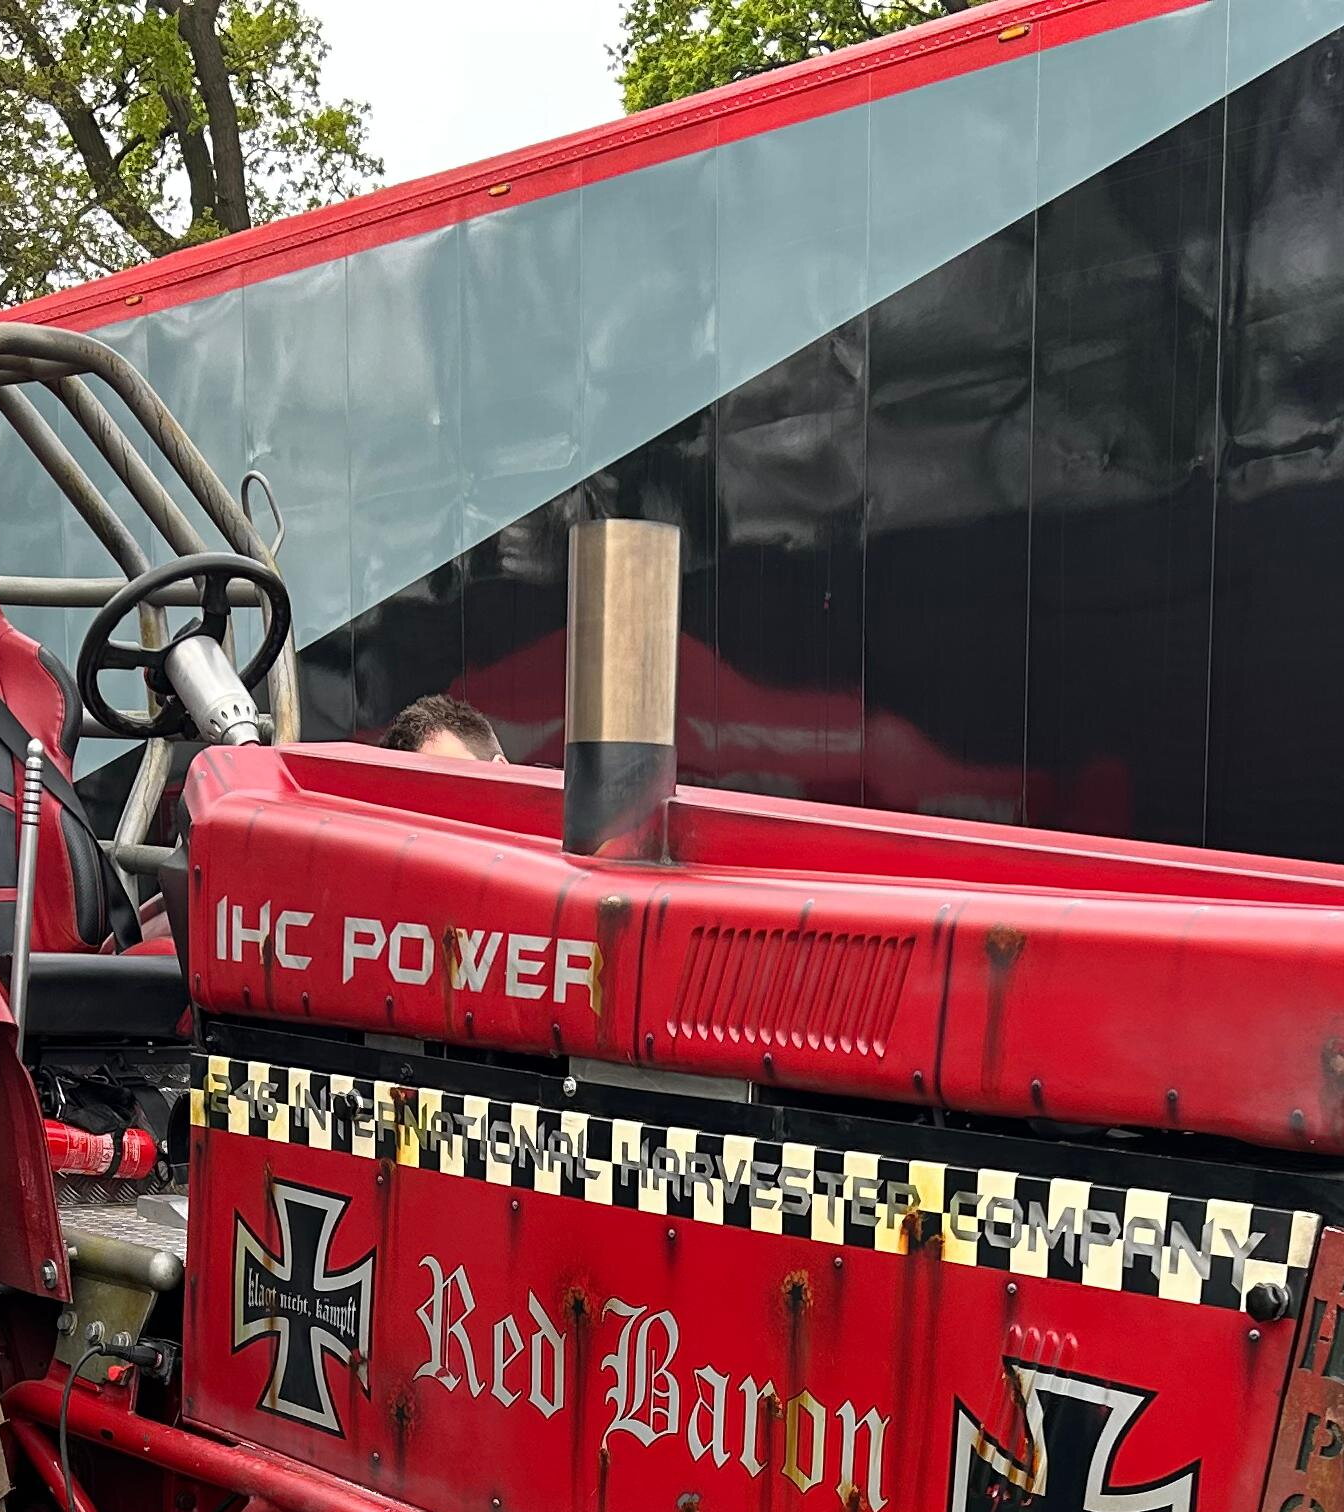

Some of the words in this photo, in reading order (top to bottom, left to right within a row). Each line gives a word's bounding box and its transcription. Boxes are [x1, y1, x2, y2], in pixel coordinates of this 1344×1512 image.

[216, 896, 315, 970] IHC
[343, 916, 603, 1017] POWER
[295, 1082, 601, 1180] INTERNATIONAL
[620, 1140, 922, 1228] HARVESTER
[950, 1190, 1266, 1292] COMPANY
[413, 1256, 566, 1420] Red
